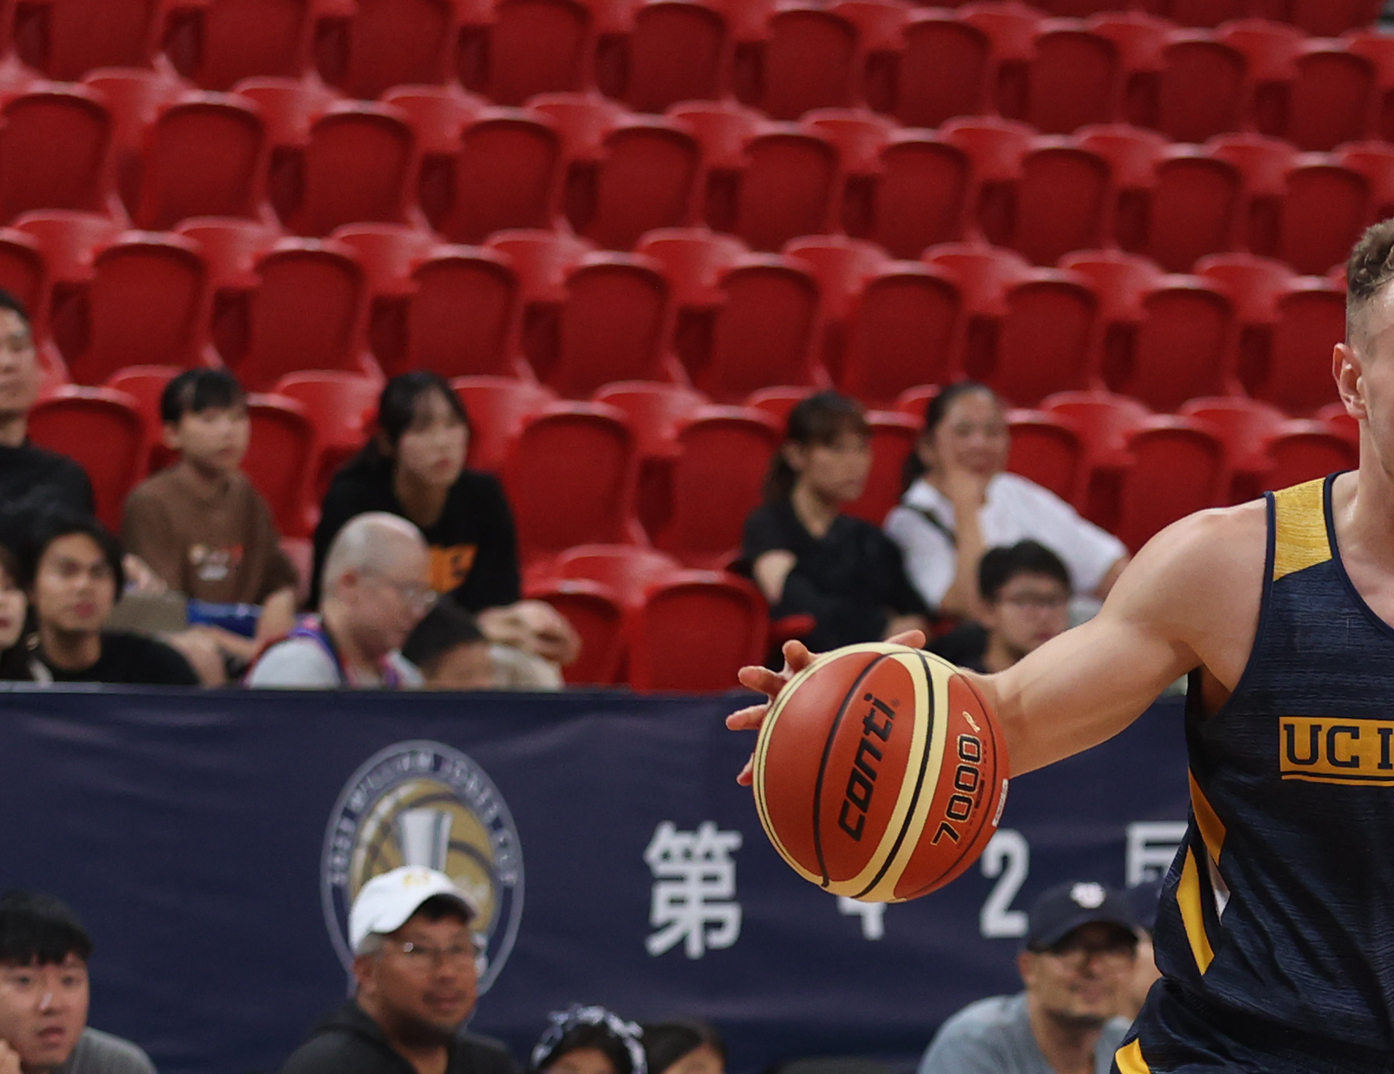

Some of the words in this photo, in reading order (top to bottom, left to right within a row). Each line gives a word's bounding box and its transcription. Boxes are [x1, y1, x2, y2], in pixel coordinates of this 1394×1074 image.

[838, 692, 896, 842] conti
[930, 733, 983, 846] 7000
[1283, 723, 1360, 769] UC
